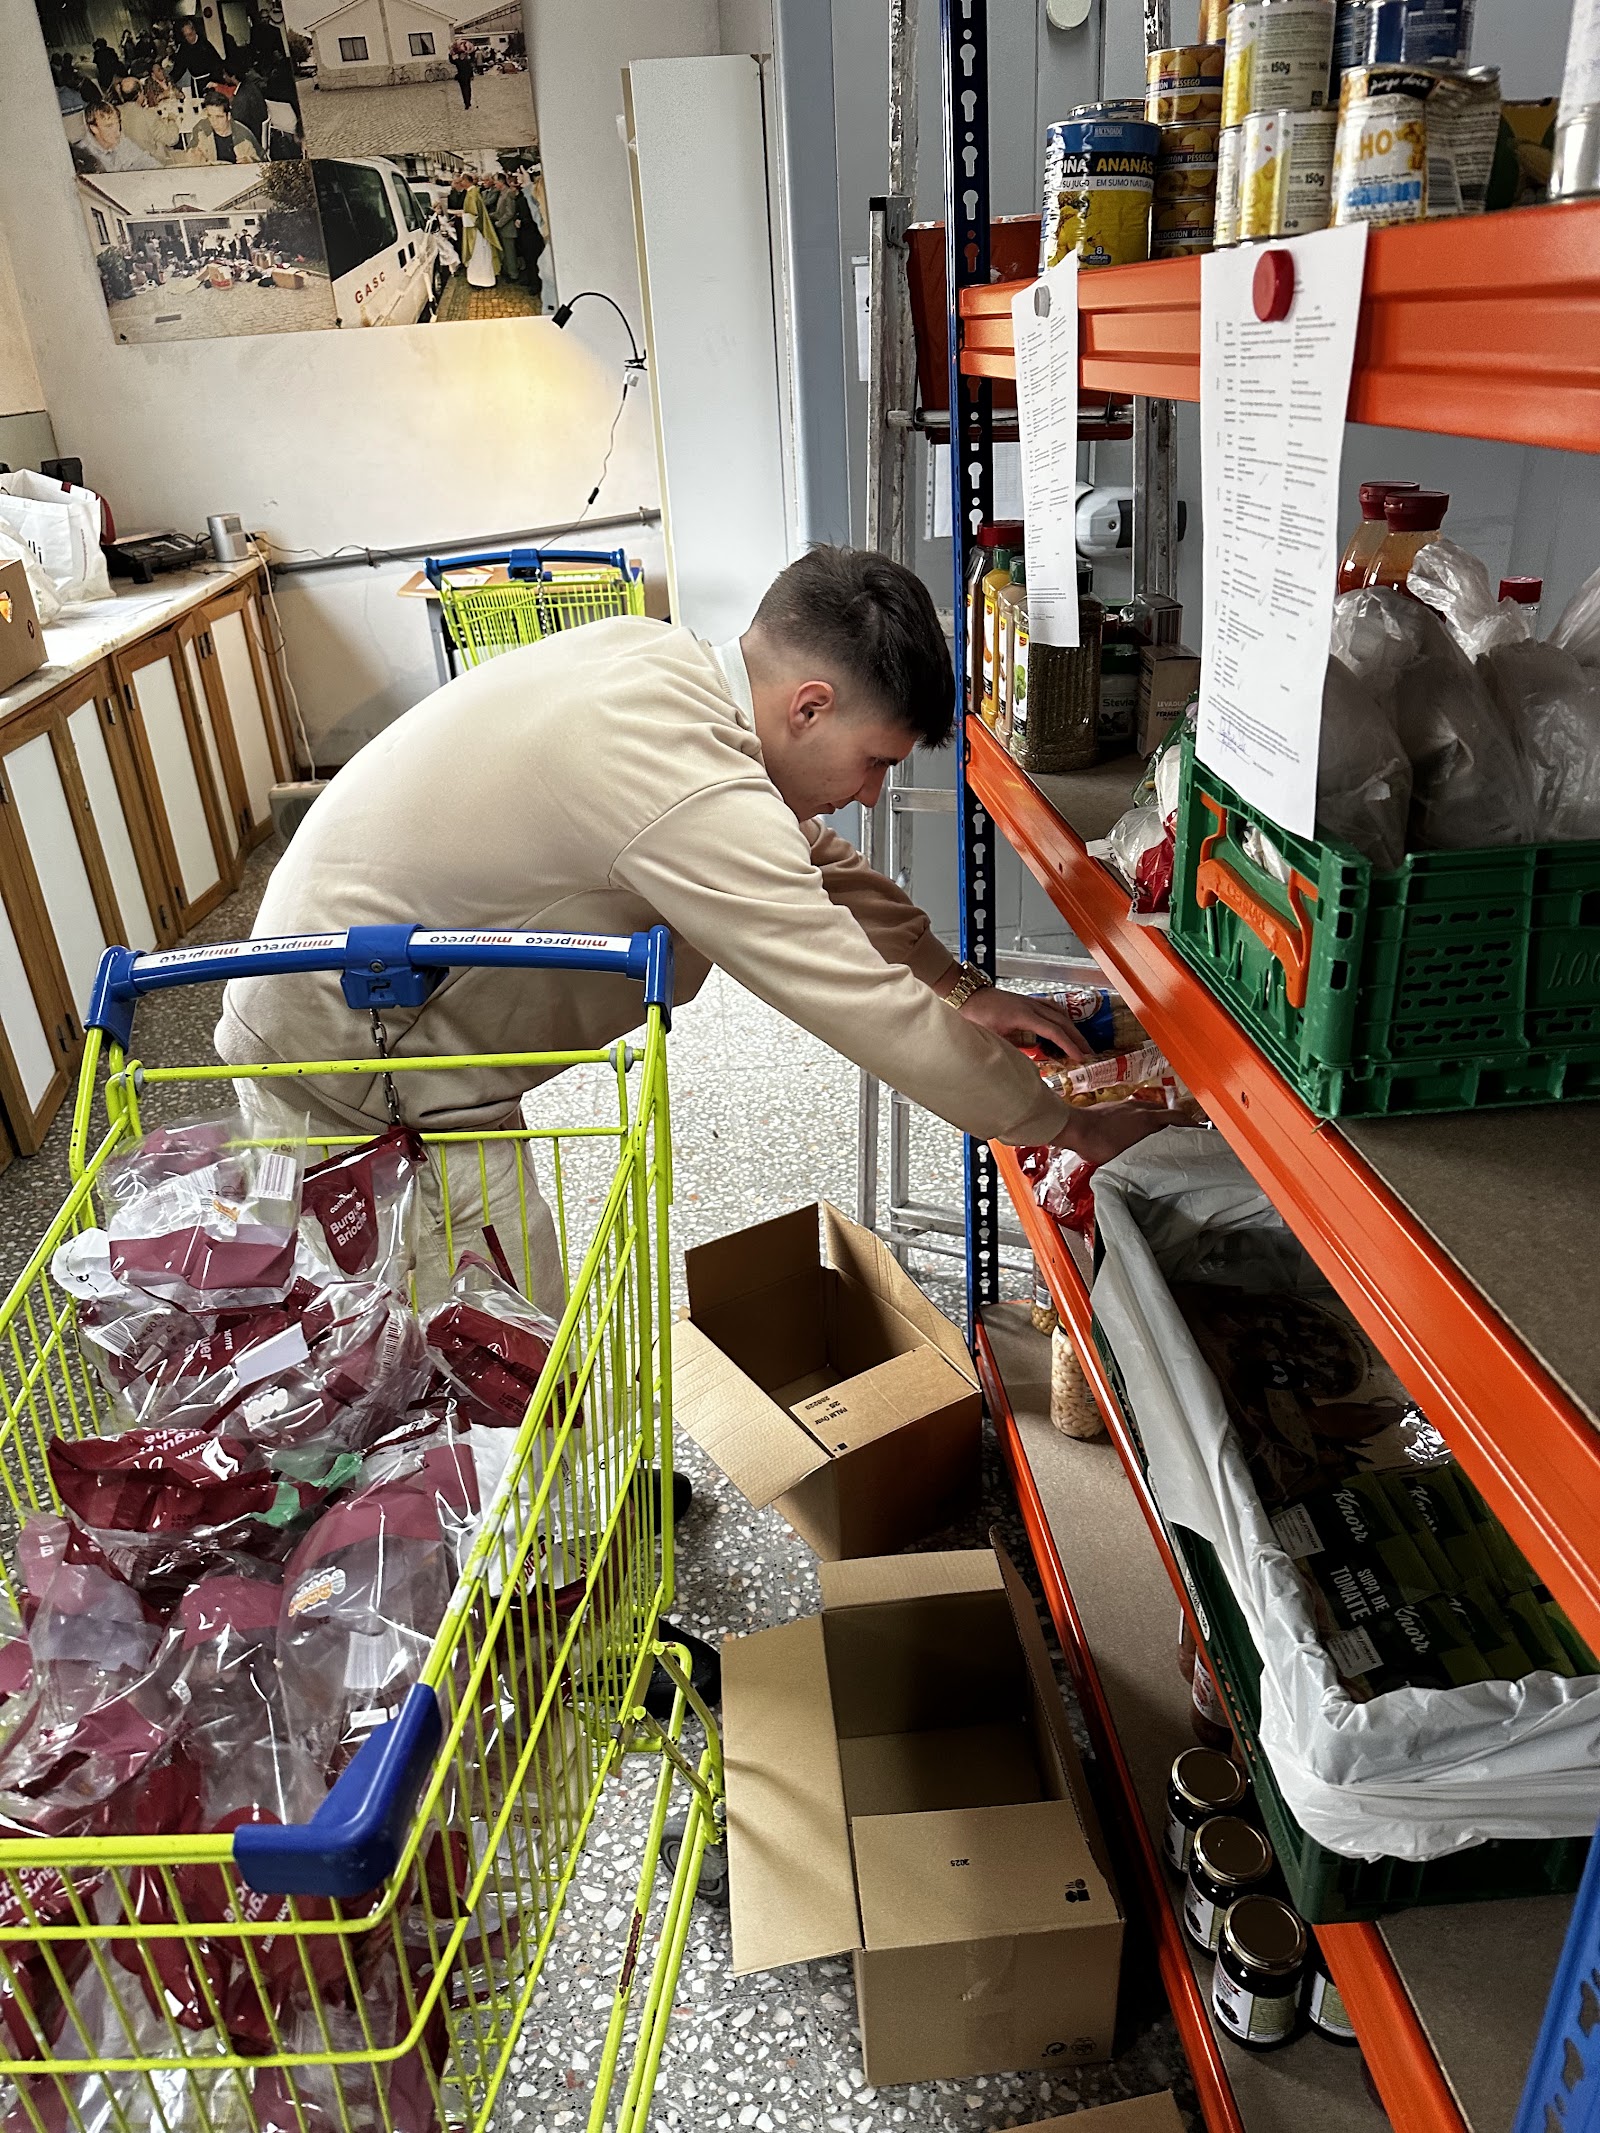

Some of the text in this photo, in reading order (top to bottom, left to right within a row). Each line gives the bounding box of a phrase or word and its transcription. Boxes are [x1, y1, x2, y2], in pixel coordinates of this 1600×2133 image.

[1271, 62, 1291, 75] 150g
[1096, 156, 1154, 175] ANANÁS
[1096, 178, 1108, 187] EM
[1108, 178, 1129, 187] SUMO
[1130, 180, 1153, 191] NATURA
[1304, 172, 1325, 186] 150g
[1096, 246, 1103, 255] 8
[355, 271, 386, 304] GASC
[1102, 698, 1136, 708] Stevia
[336, 1211, 367, 1247] Brioche
[1333, 1488, 1370, 1545] Knorr
[1330, 1565, 1372, 1623] TOMATE
[1357, 1568, 1391, 1613] SOPA DE
[1394, 1604, 1432, 1654] Knorr
